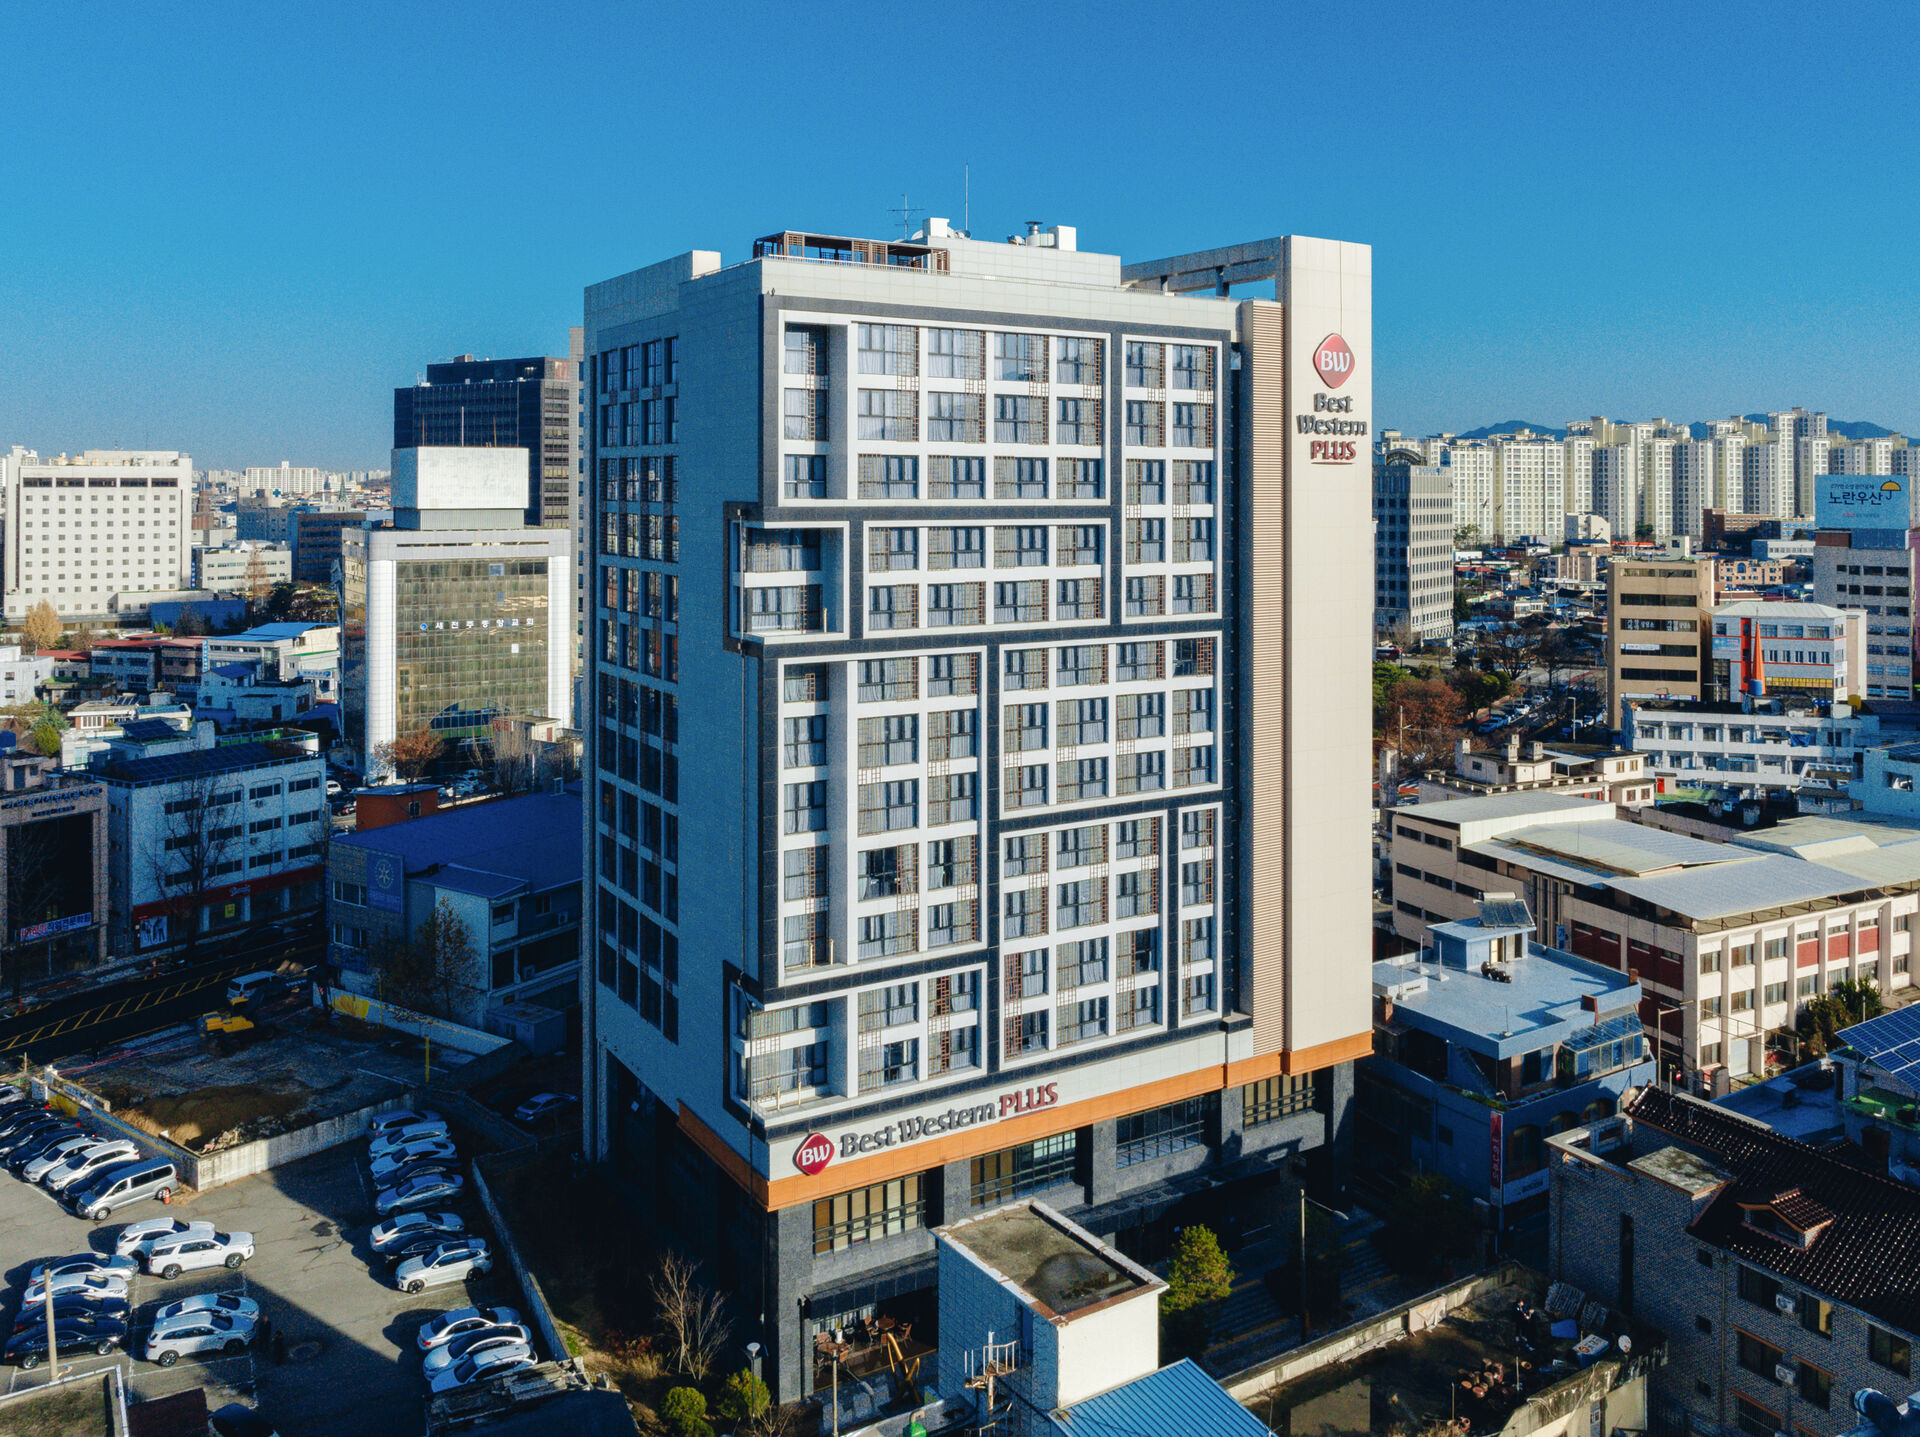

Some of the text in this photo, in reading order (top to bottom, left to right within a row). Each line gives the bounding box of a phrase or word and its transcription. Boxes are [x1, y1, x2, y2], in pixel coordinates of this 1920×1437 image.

[1320, 350, 1350, 373] BW
[1314, 392, 1353, 413] Best
[1296, 414, 1368, 436] Western
[1310, 440, 1357, 460] PLUS
[1828, 491, 1884, 506] 노란우산
[801, 1082, 1059, 1167] BW Best Western PLUS
